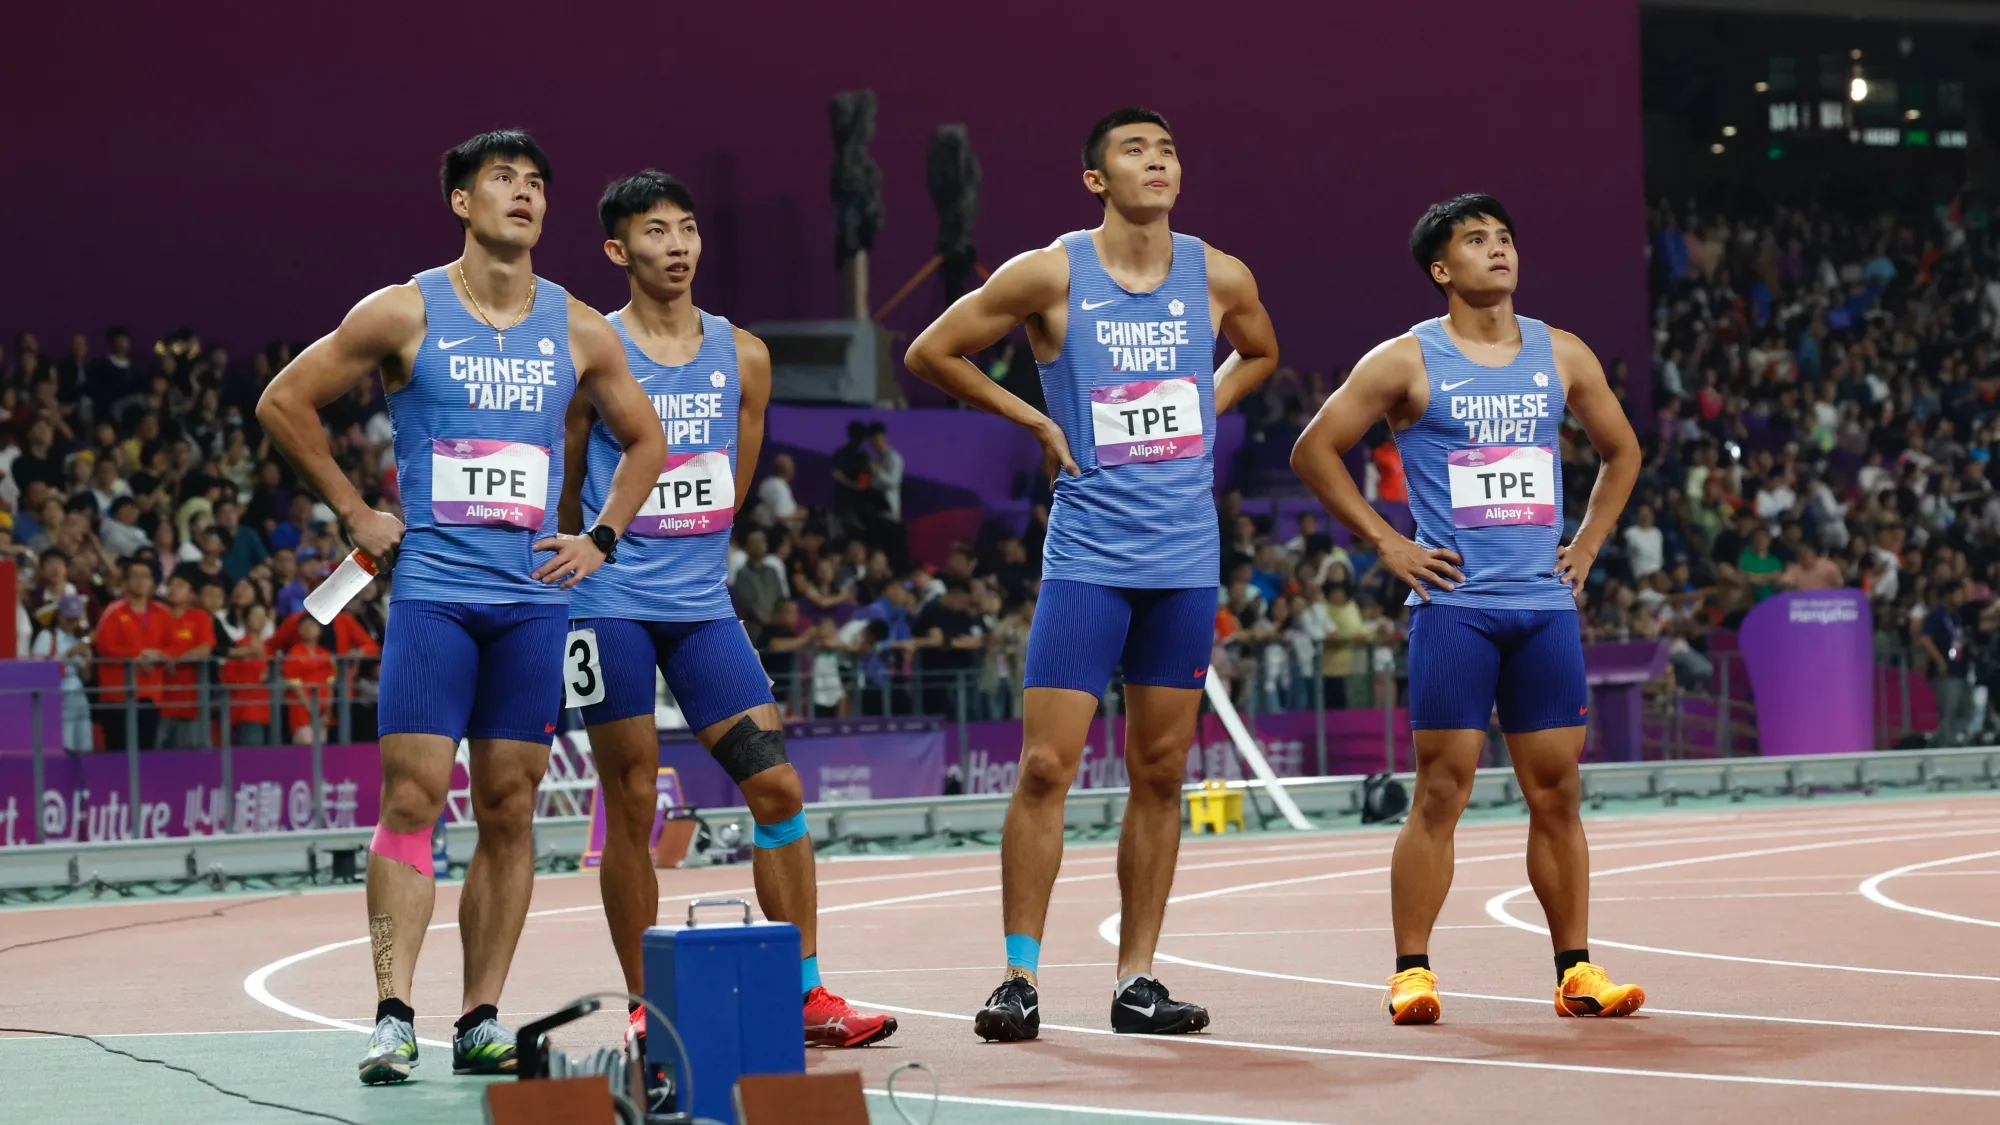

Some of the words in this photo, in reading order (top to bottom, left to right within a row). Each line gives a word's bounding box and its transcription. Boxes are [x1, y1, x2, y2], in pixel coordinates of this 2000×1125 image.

[1096, 320, 1190, 346] CHINESE
[450, 355, 557, 386] CHINESE
[1108, 346, 1176, 372] TAIPEI
[464, 383, 544, 412] TAIPEI
[648, 393, 723, 419] HINESE
[1451, 393, 1549, 420] CHINESE
[1119, 405, 1179, 436] TPE
[1464, 419, 1537, 444] TAIPEI
[462, 467, 526, 498] TPE
[655, 478, 713, 509] TPE
[1476, 471, 1536, 499] TPE
[568, 639, 597, 697] 3
